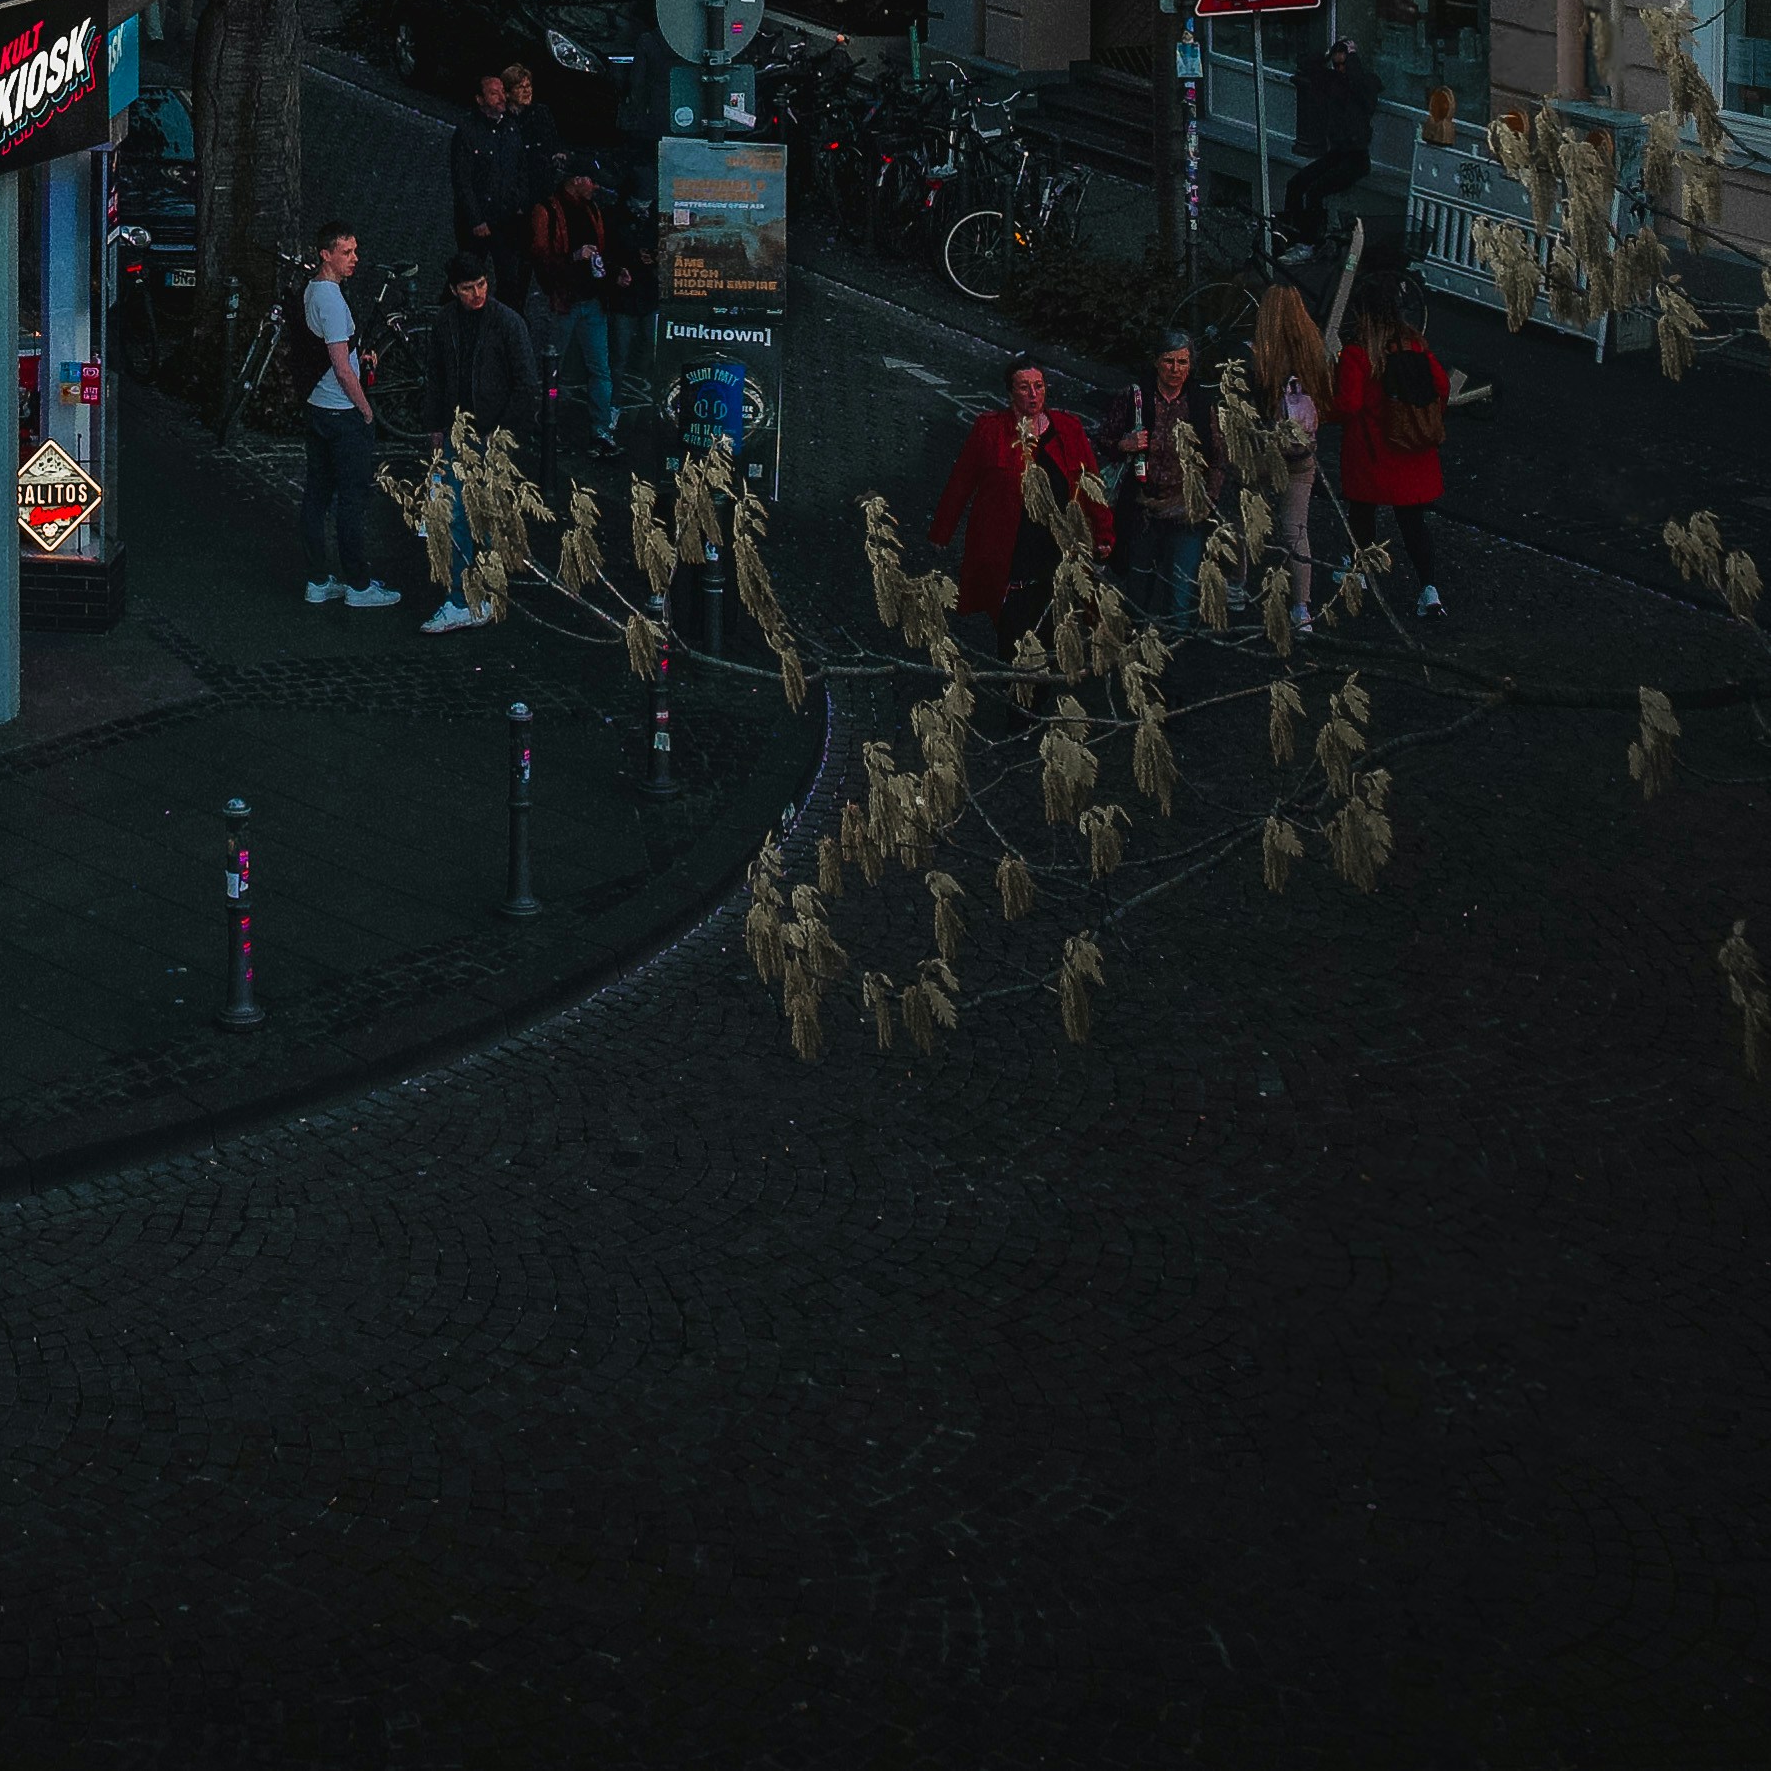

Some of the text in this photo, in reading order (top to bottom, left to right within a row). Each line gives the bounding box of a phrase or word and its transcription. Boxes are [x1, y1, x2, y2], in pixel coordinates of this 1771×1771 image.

[0, 20, 45, 75] KULT
[673, 278, 724, 289] HIDDEN
[665, 321, 772, 347] [unknown]
